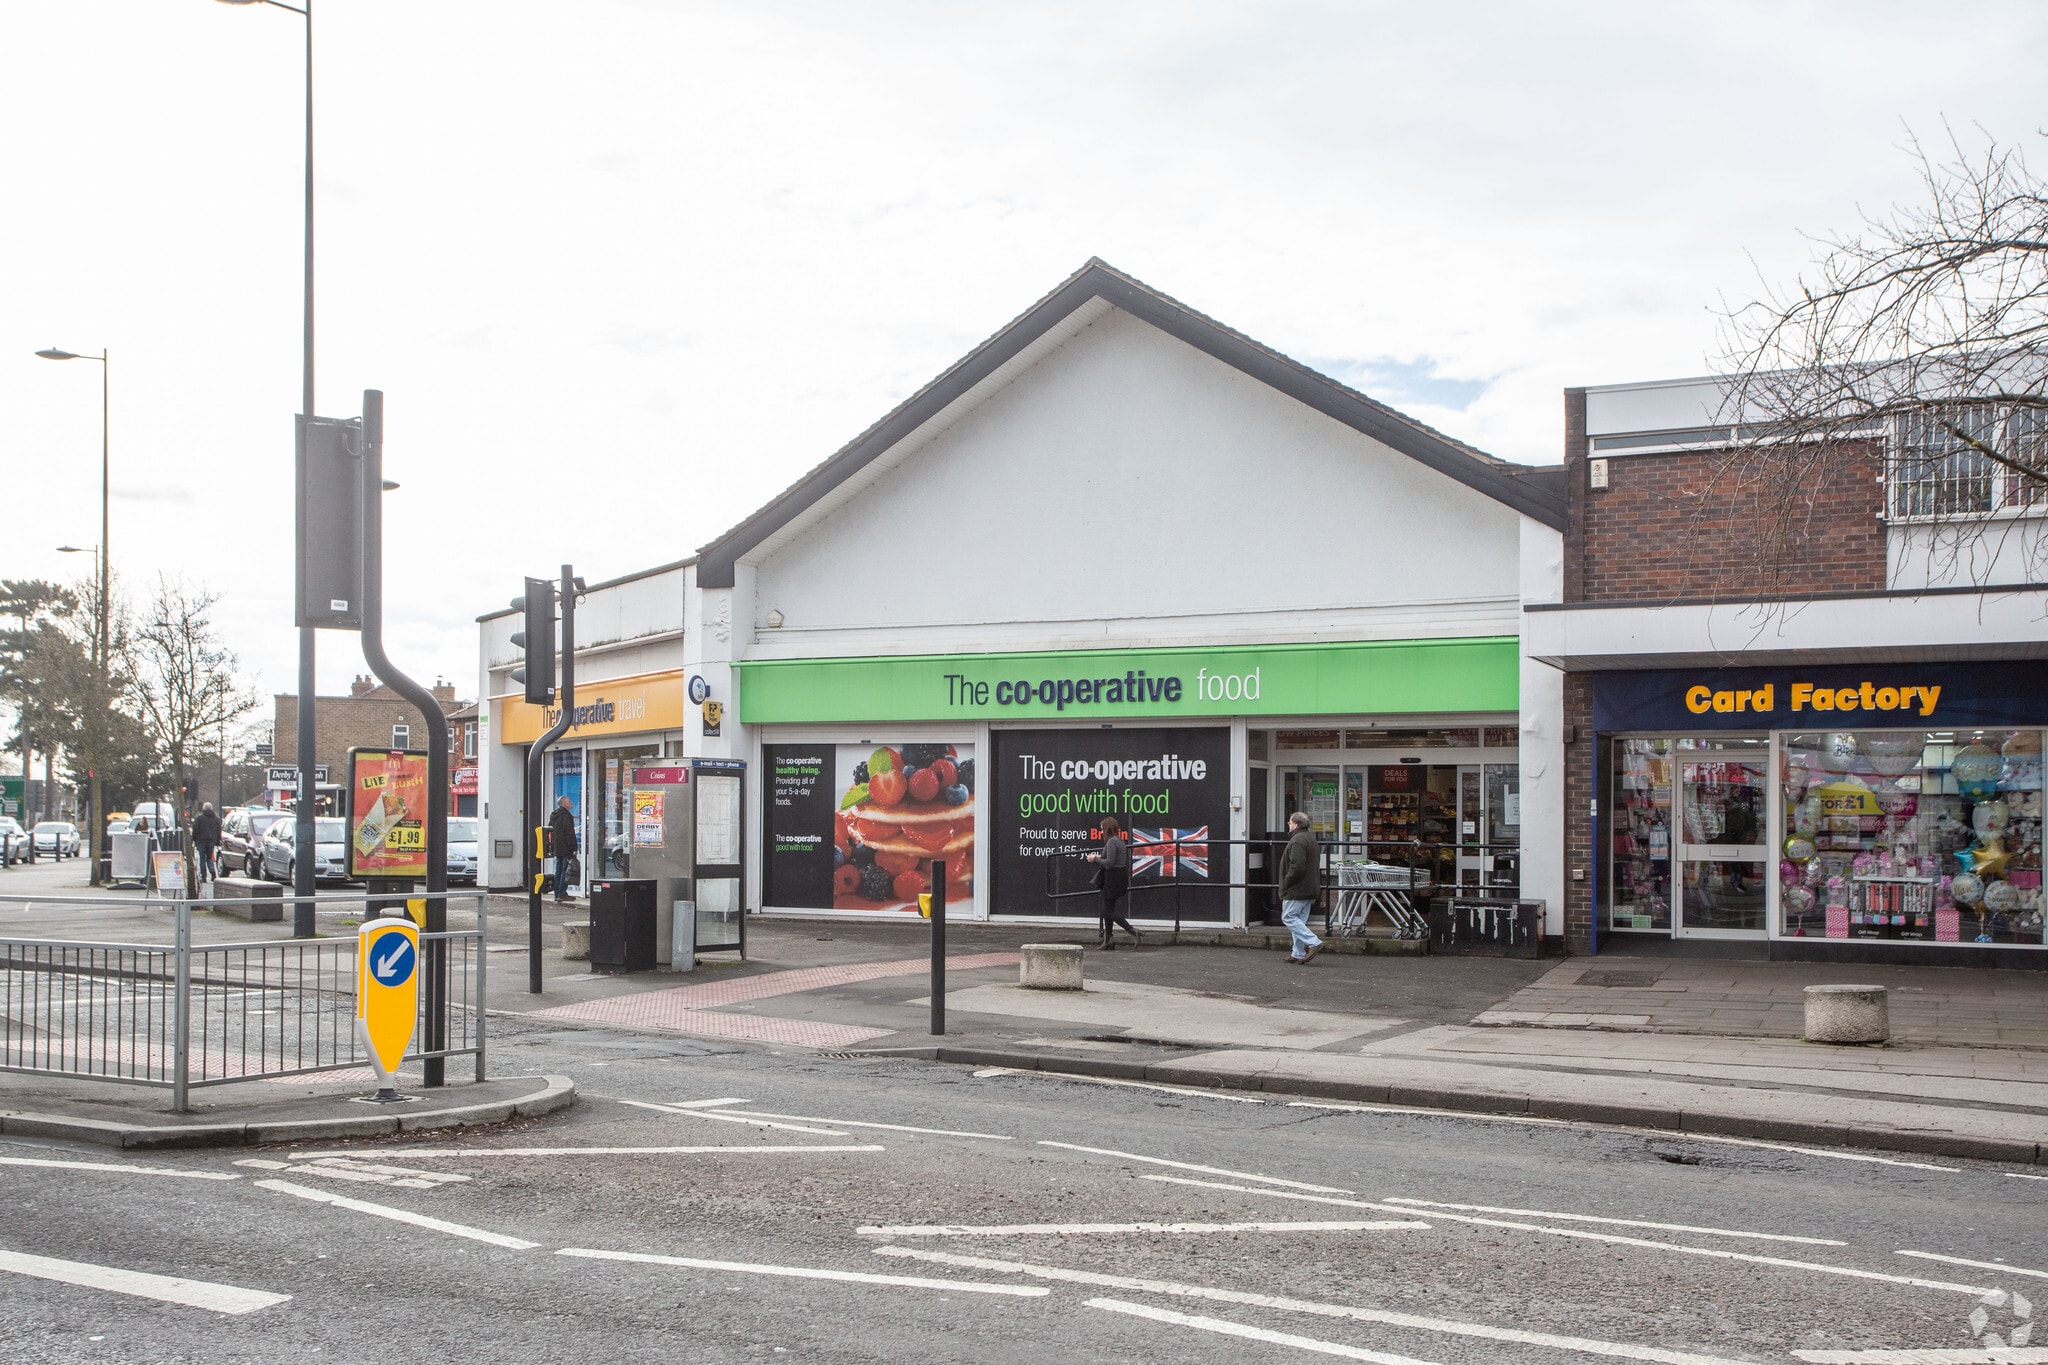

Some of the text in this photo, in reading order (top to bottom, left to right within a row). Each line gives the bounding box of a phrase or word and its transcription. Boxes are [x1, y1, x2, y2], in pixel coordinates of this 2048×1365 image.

[943, 667, 1261, 711] The co-operative food
[1685, 682, 1942, 716] Card Factory
[542, 691, 647, 732] The cperative travel
[776, 757, 822, 766] The co-operative
[776, 767, 821, 775] healthy living.
[1019, 754, 1207, 785] The co-operative
[1384, 769, 1408, 777] DEALS
[272, 770, 292, 781] Derby
[650, 772, 666, 780] Coins
[776, 777, 801, 786] Providing
[809, 777, 815, 785] of
[776, 787, 811, 797] your 5-a-day
[776, 798, 793, 806] foods.
[1020, 789, 1170, 818] good with food
[389, 830, 420, 845] £1.99
[776, 834, 822, 843] The co-operative
[1020, 827, 1129, 840] Proud to serve Brin
[776, 844, 789, 852] good
[1019, 845, 1032, 857] for
[1034, 847, 1056, 857] over
[1059, 845, 1077, 858] 165
